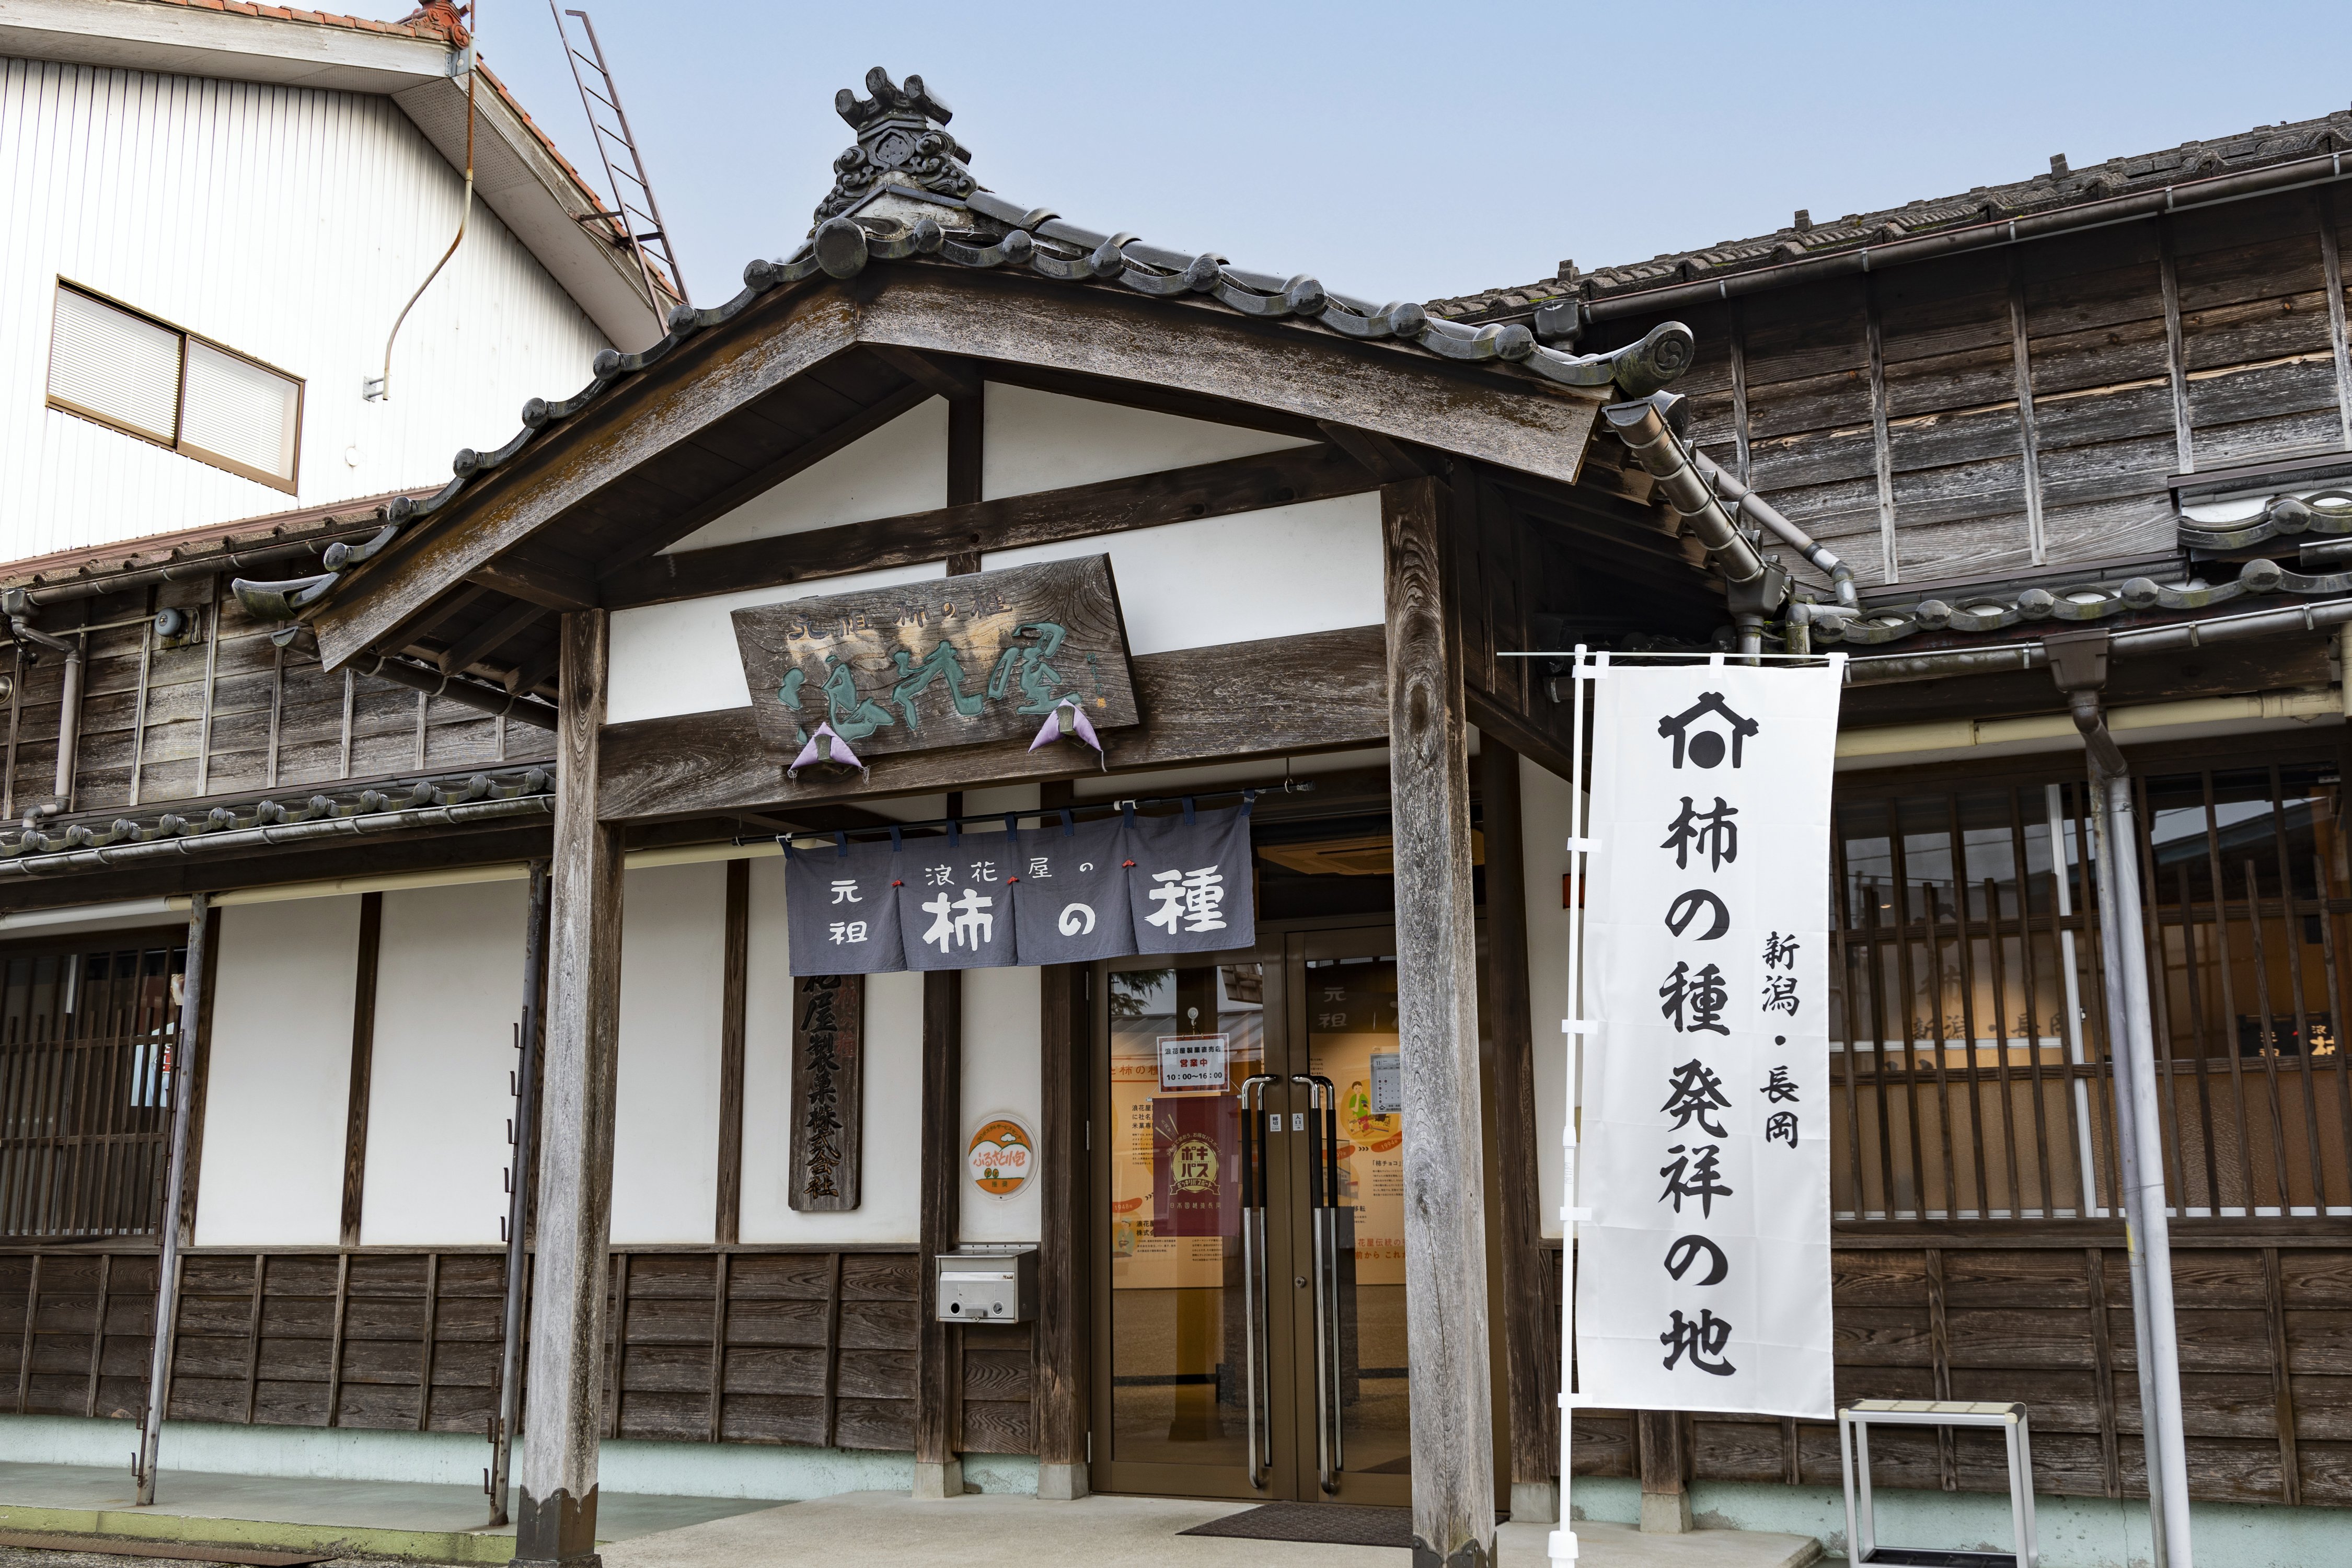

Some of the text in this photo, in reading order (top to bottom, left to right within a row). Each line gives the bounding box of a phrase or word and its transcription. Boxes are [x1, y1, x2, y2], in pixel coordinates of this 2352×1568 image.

[777, 621, 1083, 745] 浪花屋
[925, 857, 1094, 886] 浪花屋の
[829, 880, 868, 944] 元祖
[921, 864, 1227, 953] 柿の種
[1318, 986, 1347, 1029] 元祖
[1165, 1045, 1221, 1055] 浪花屋製菓直売店
[1759, 931, 1801, 1149] 新潟・長岡
[1180, 1058, 1208, 1067] 営業中
[1659, 796, 1737, 1377] 柿の種発祥の地
[973, 1150, 1025, 1167] ふるさと小包
[1181, 1146, 1208, 1161] ポキ
[1181, 1163, 1209, 1178] パス
[1355, 1238, 1405, 1247] 花屋伝統の
